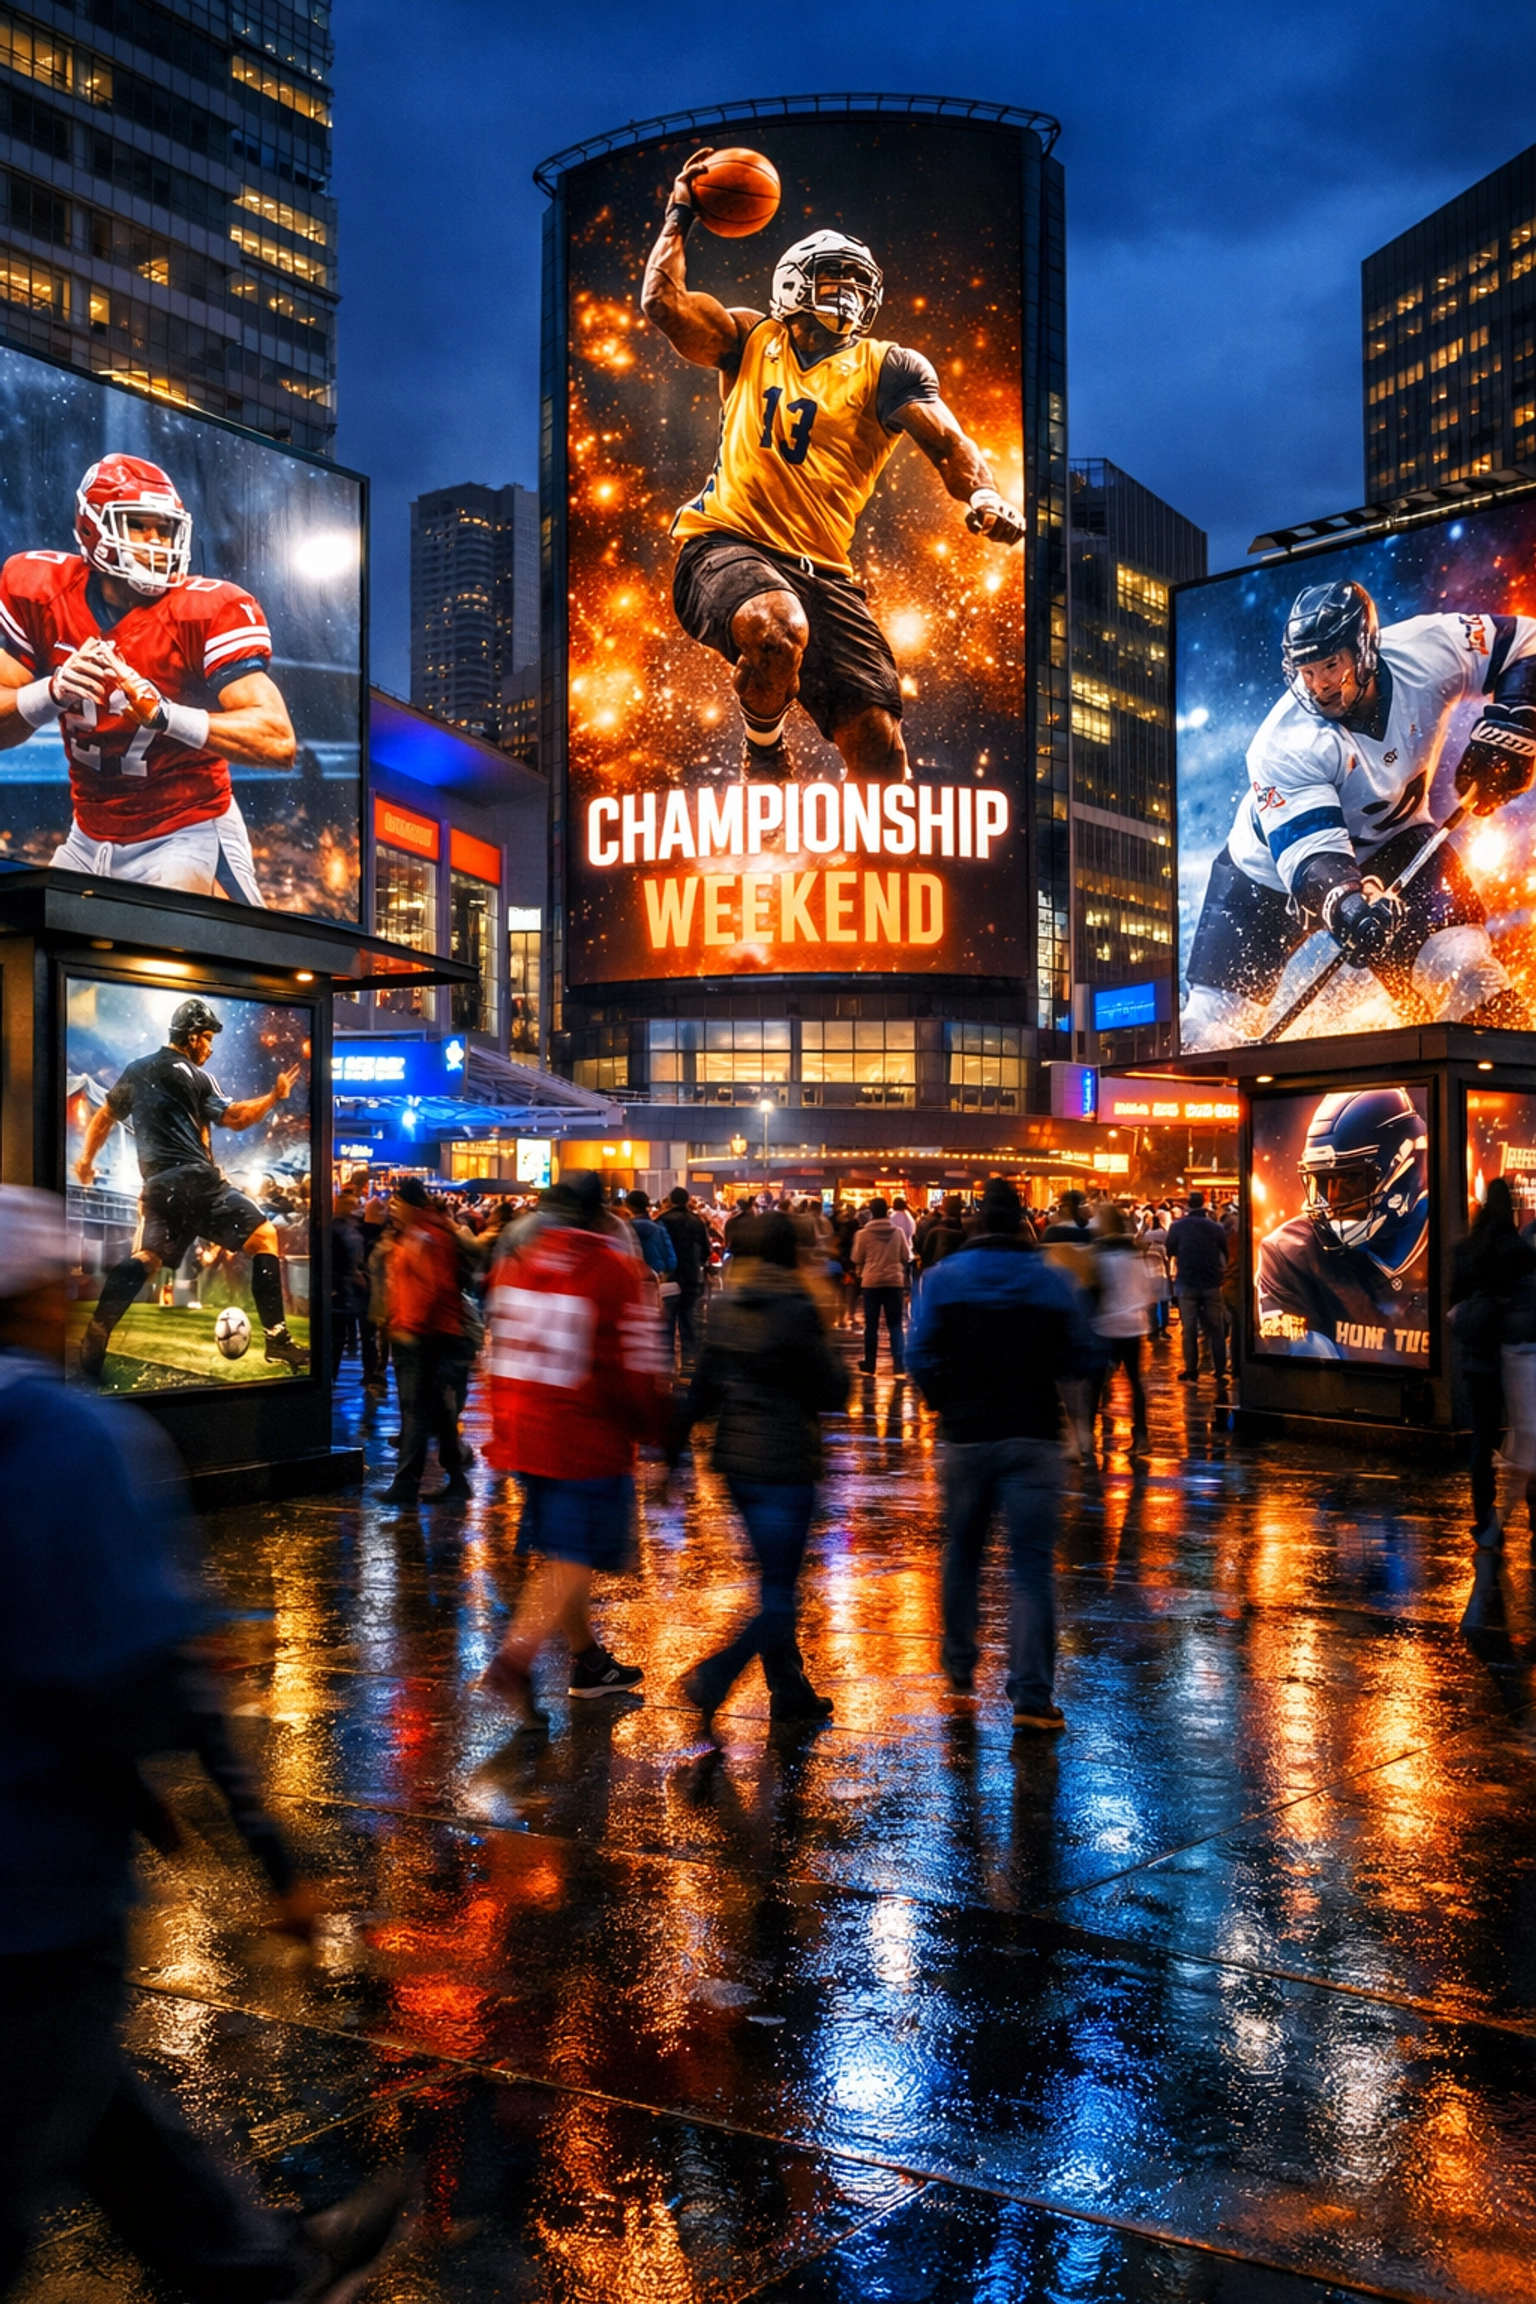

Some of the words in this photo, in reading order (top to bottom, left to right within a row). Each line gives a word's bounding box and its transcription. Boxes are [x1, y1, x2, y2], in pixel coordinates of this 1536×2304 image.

[760, 386, 818, 465] 13
[588, 783, 1009, 867] CHAMPIONSHIP
[643, 871, 943, 949] WEEKEND
